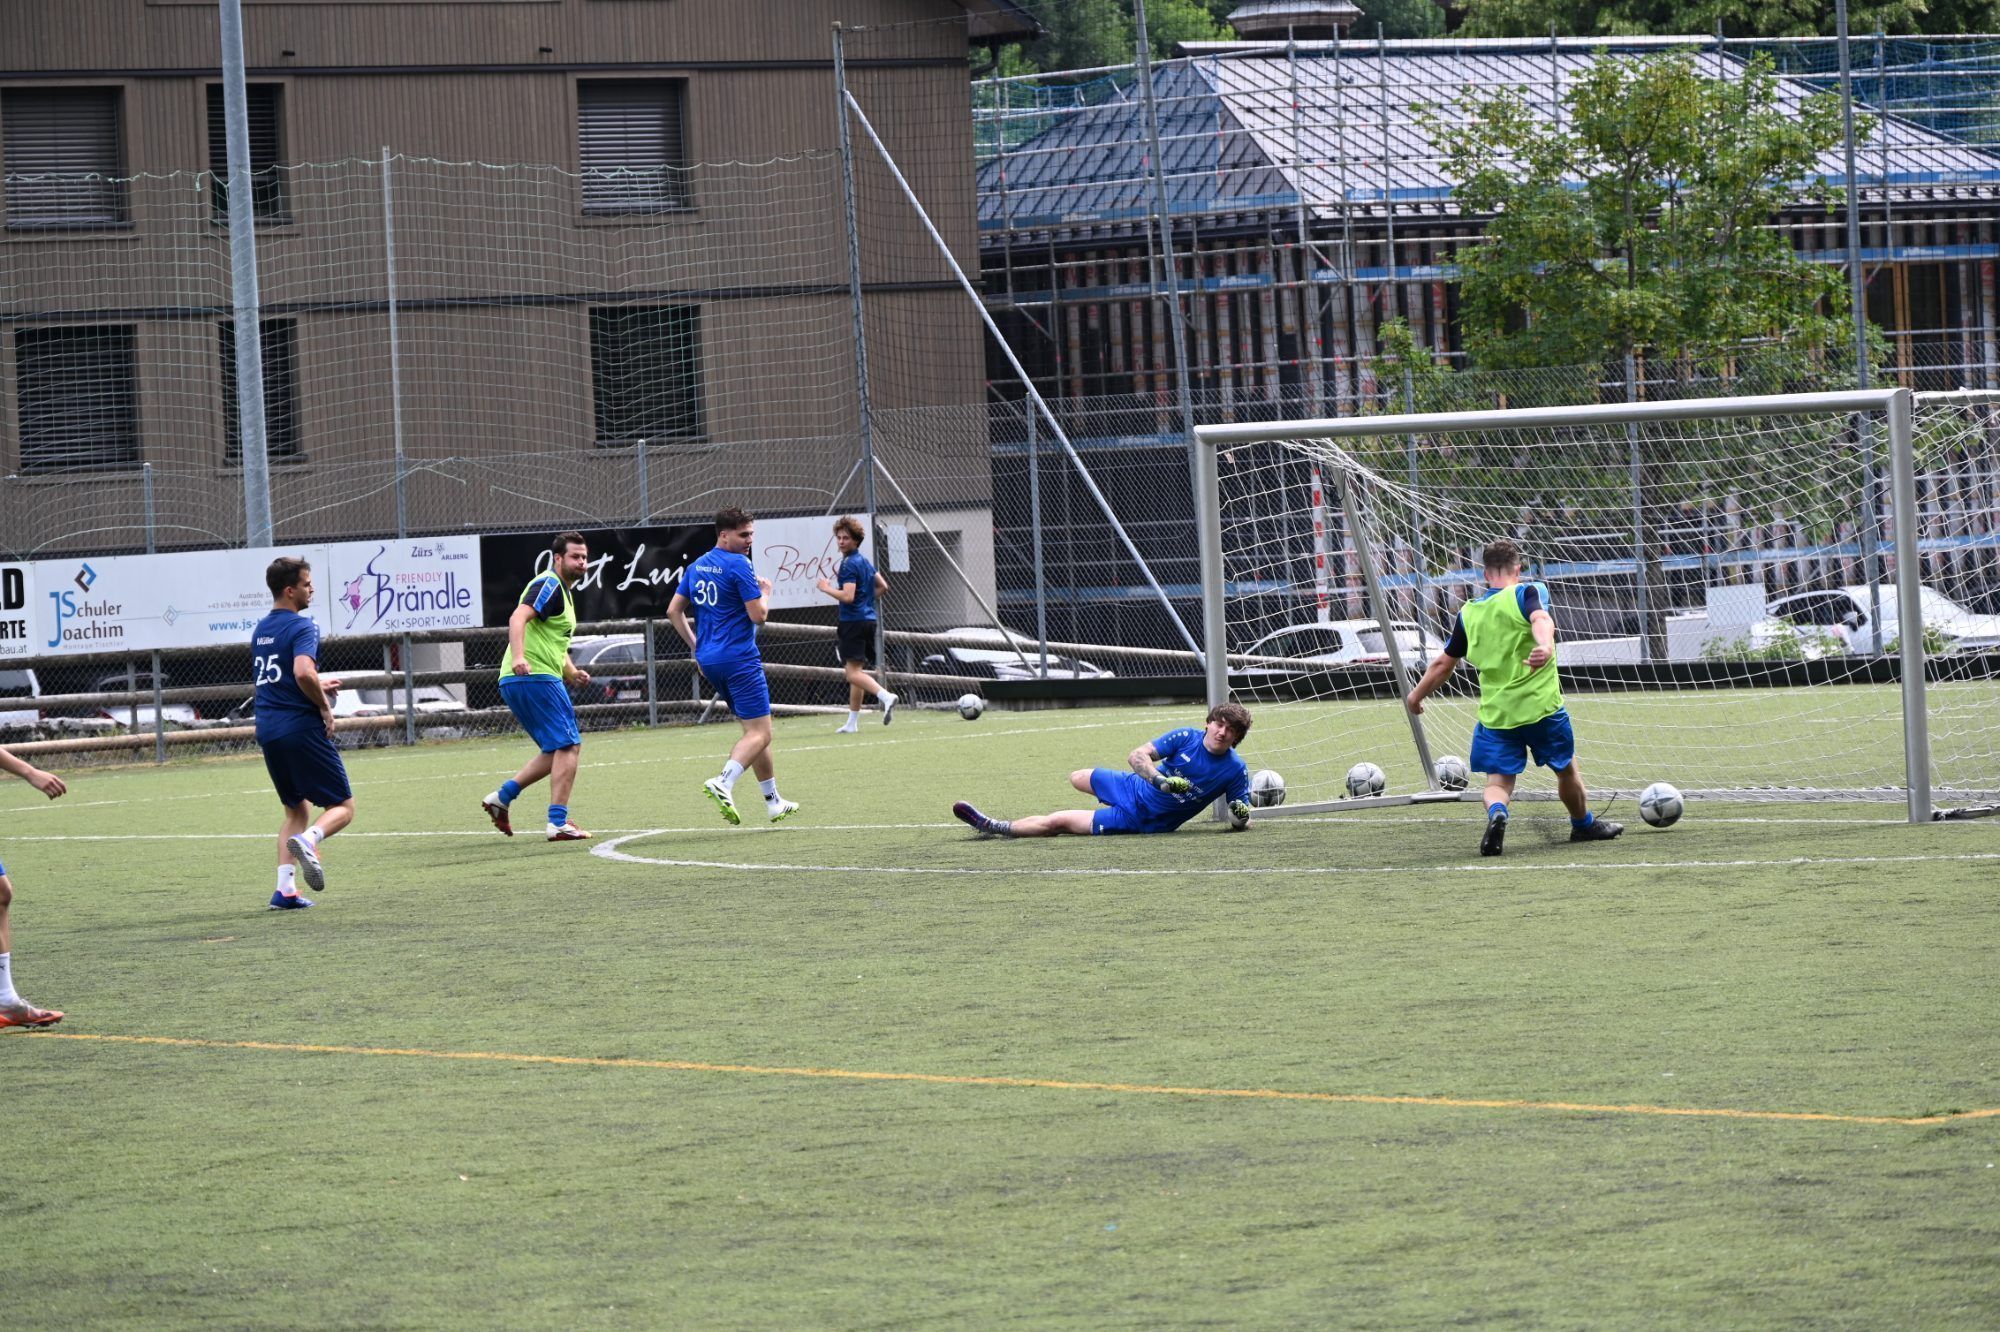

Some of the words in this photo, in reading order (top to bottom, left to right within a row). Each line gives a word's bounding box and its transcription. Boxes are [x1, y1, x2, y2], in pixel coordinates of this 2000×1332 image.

[411, 545, 433, 558] Zürs
[441, 553, 468, 561] ARLBERG
[395, 572, 442, 584] FRIENDLY
[367, 567, 471, 627] Brändle
[694, 580, 718, 606] 30
[772, 587, 816, 597] RESTAU
[254, 653, 282, 687] 25
